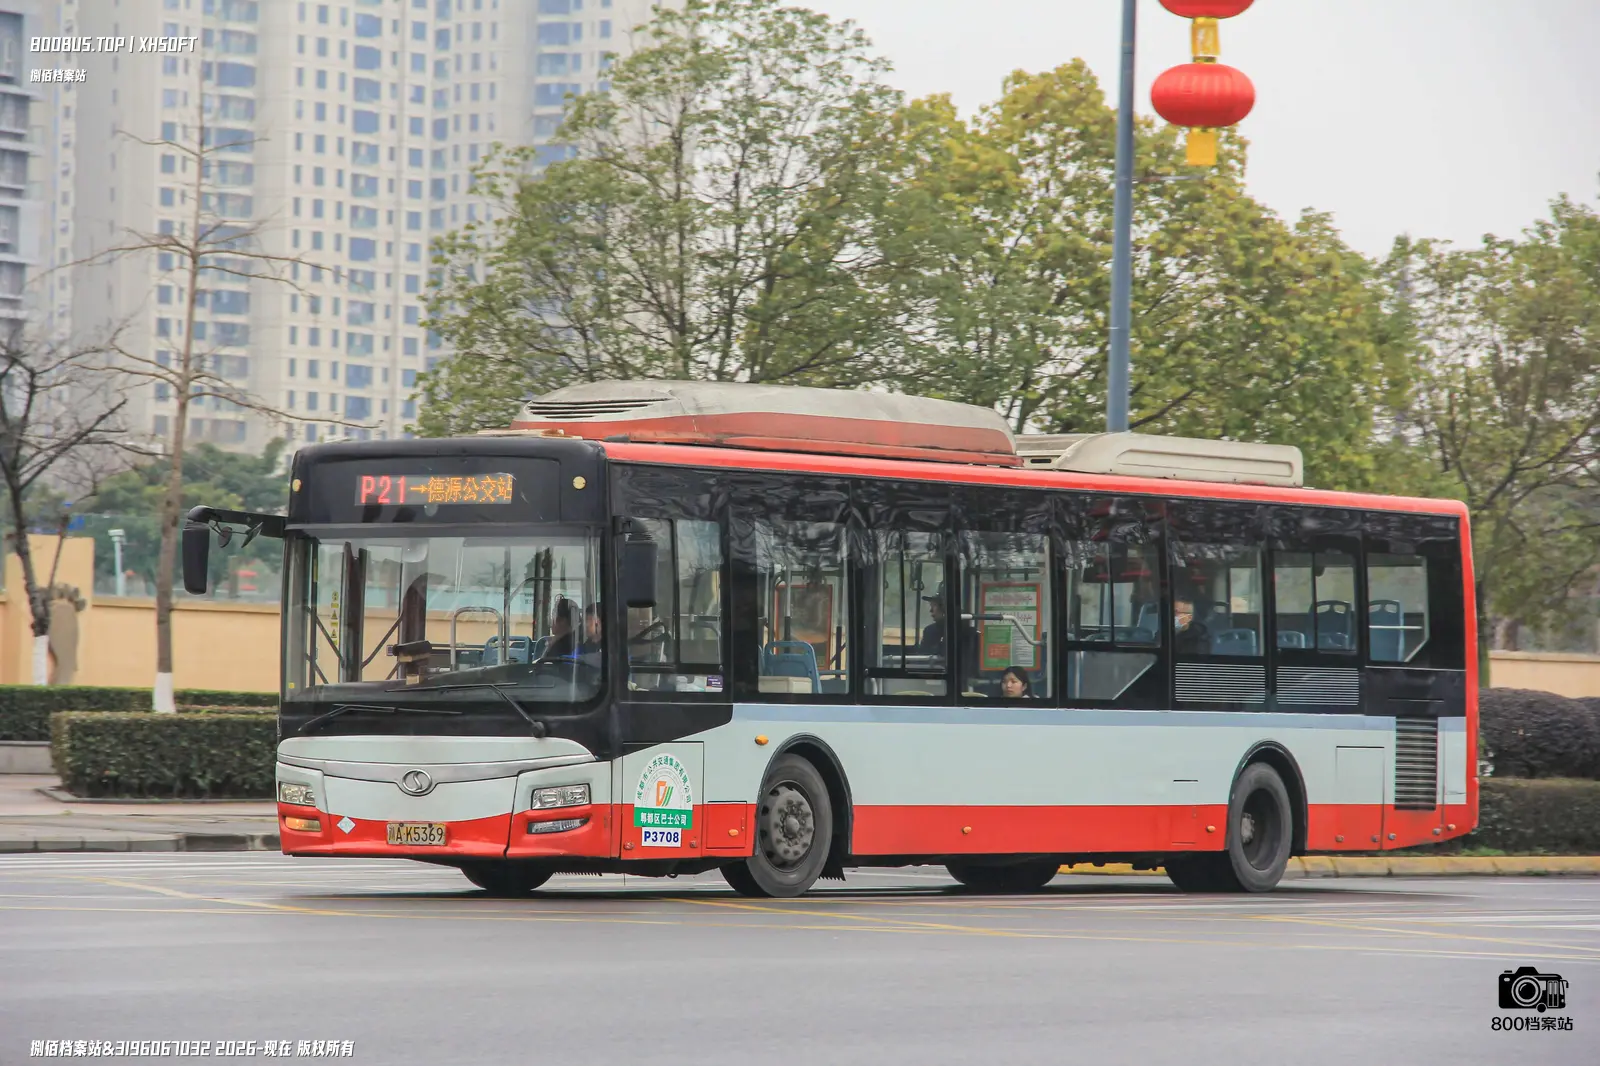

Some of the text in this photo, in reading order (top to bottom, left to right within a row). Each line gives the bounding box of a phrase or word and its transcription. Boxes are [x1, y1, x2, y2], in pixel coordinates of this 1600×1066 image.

[361, 475, 512, 503] P21 德源公交站
[644, 830, 680, 843] P3708
